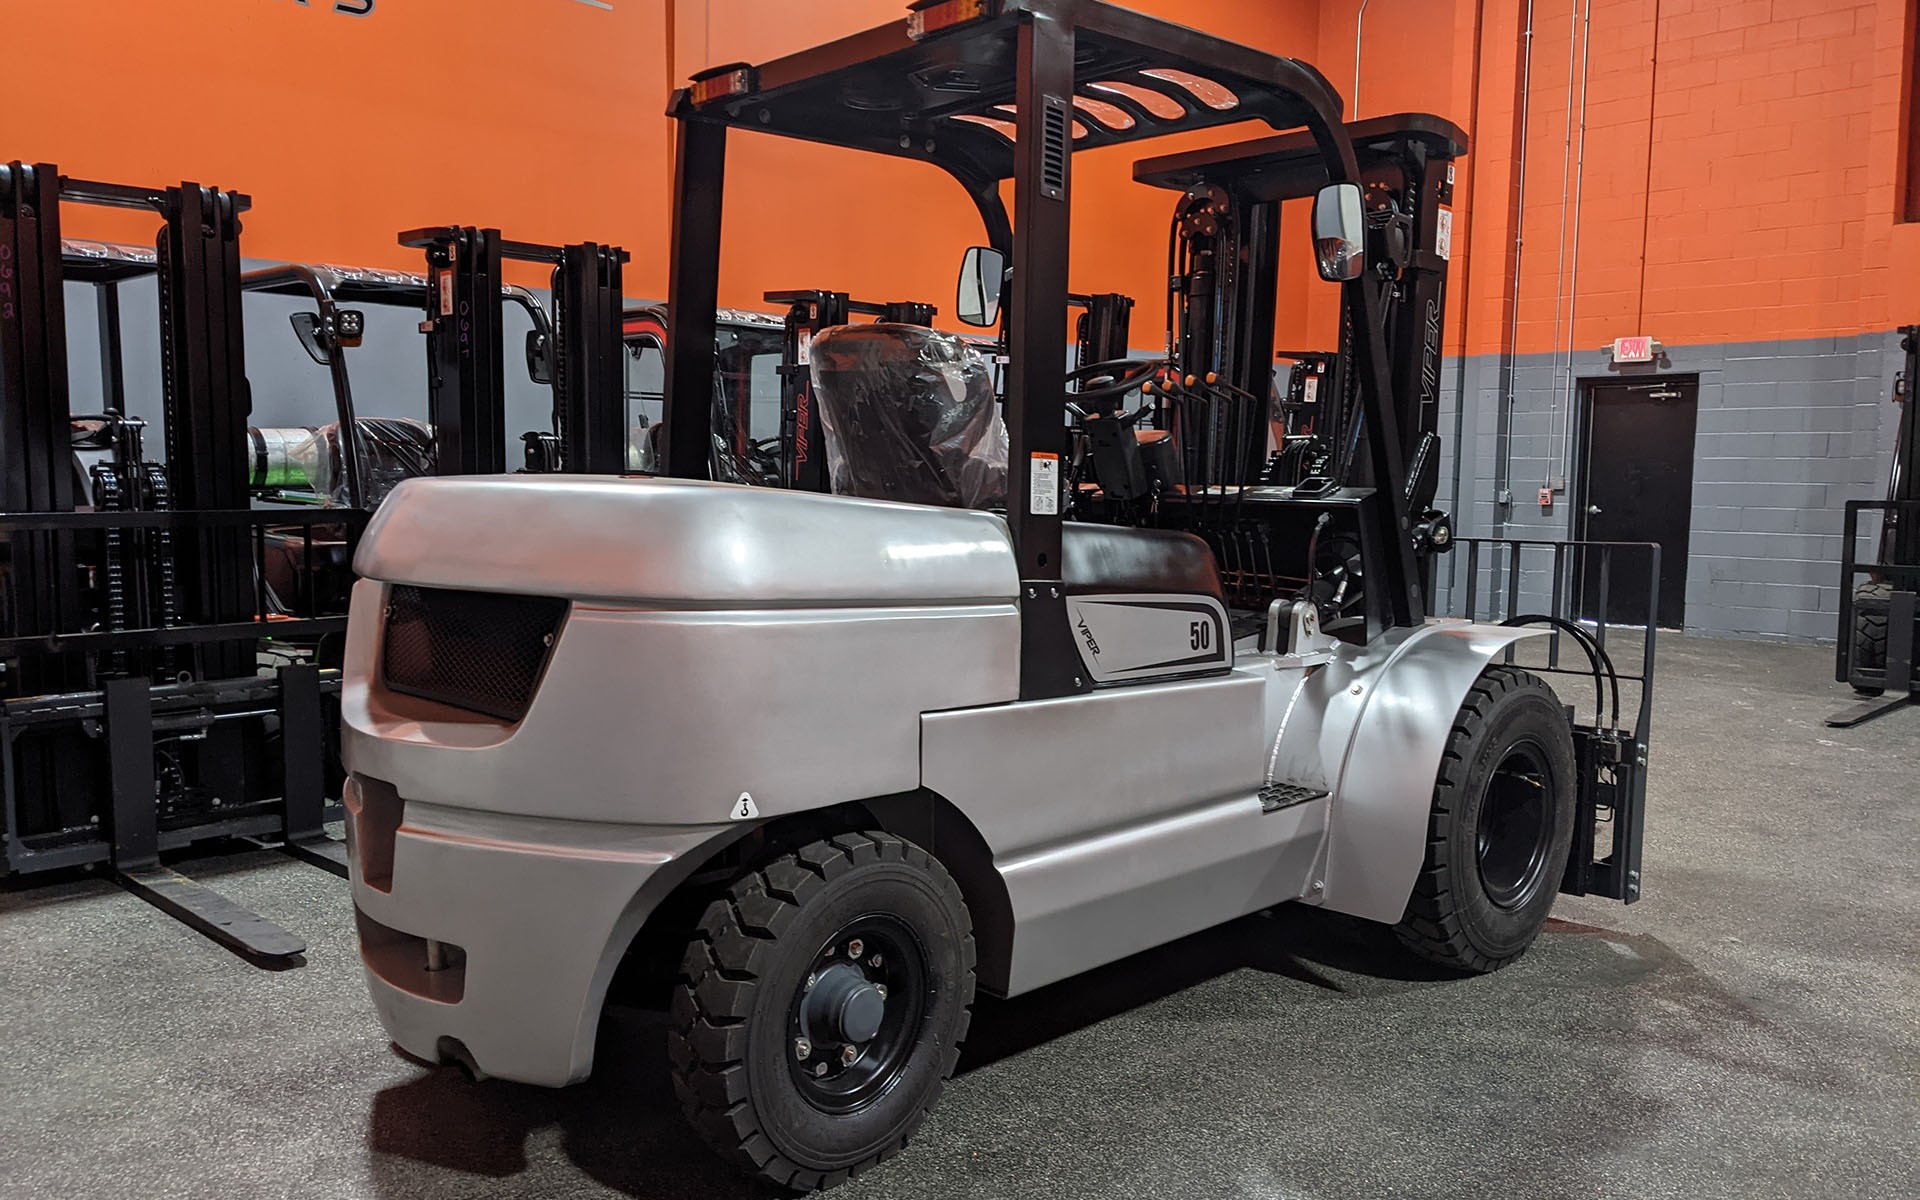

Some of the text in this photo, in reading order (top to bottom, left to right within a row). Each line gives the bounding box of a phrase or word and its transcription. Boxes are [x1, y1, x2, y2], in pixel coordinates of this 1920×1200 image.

[1418, 281, 1442, 432] VIPER
[1620, 341, 1646, 358] EXIT
[795, 380, 810, 480] VIPER
[1077, 609, 1101, 664] VIPER
[1190, 620, 1210, 651] 50
